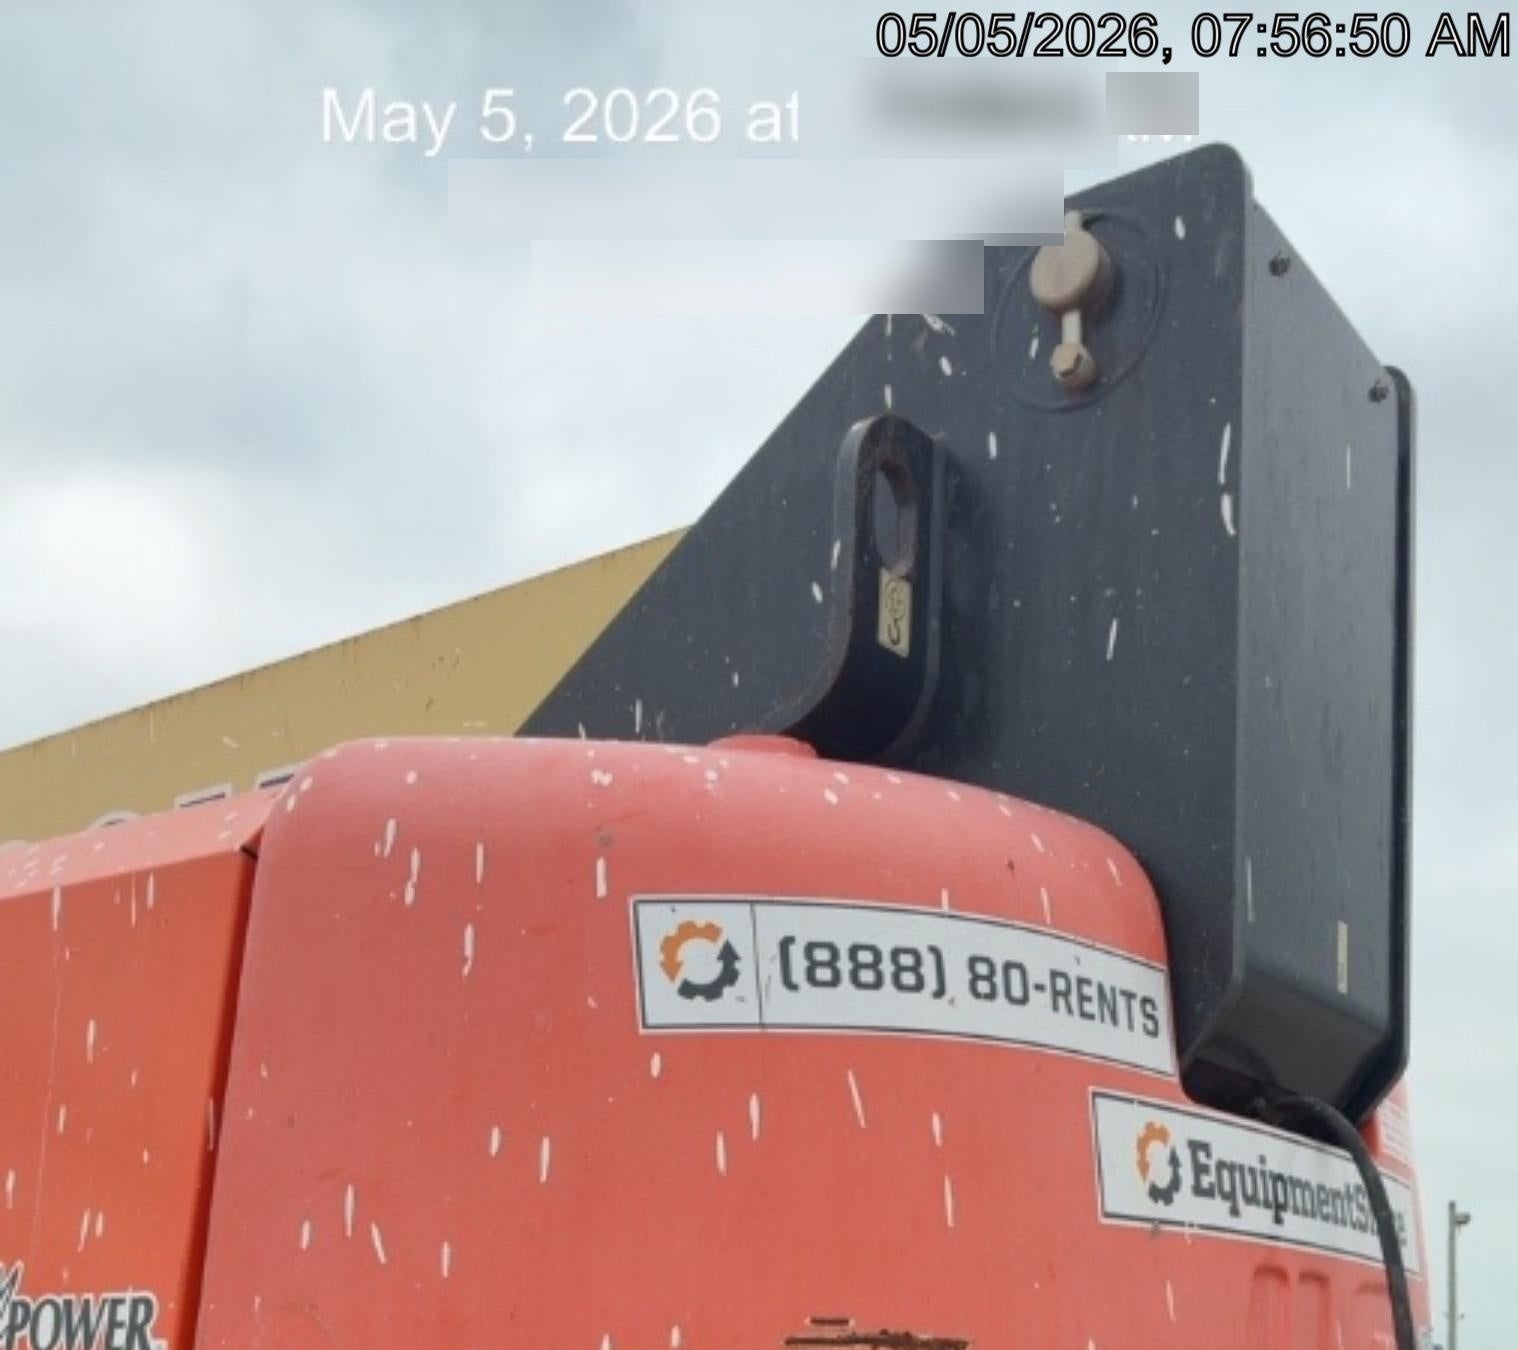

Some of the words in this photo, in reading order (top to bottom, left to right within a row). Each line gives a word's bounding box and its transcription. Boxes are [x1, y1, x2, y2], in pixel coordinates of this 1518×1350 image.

[777, 935, 946, 999] (888)
[967, 955, 1160, 1039] 80-RENTS
[1187, 1138, 1407, 1247] EquipmentSe
